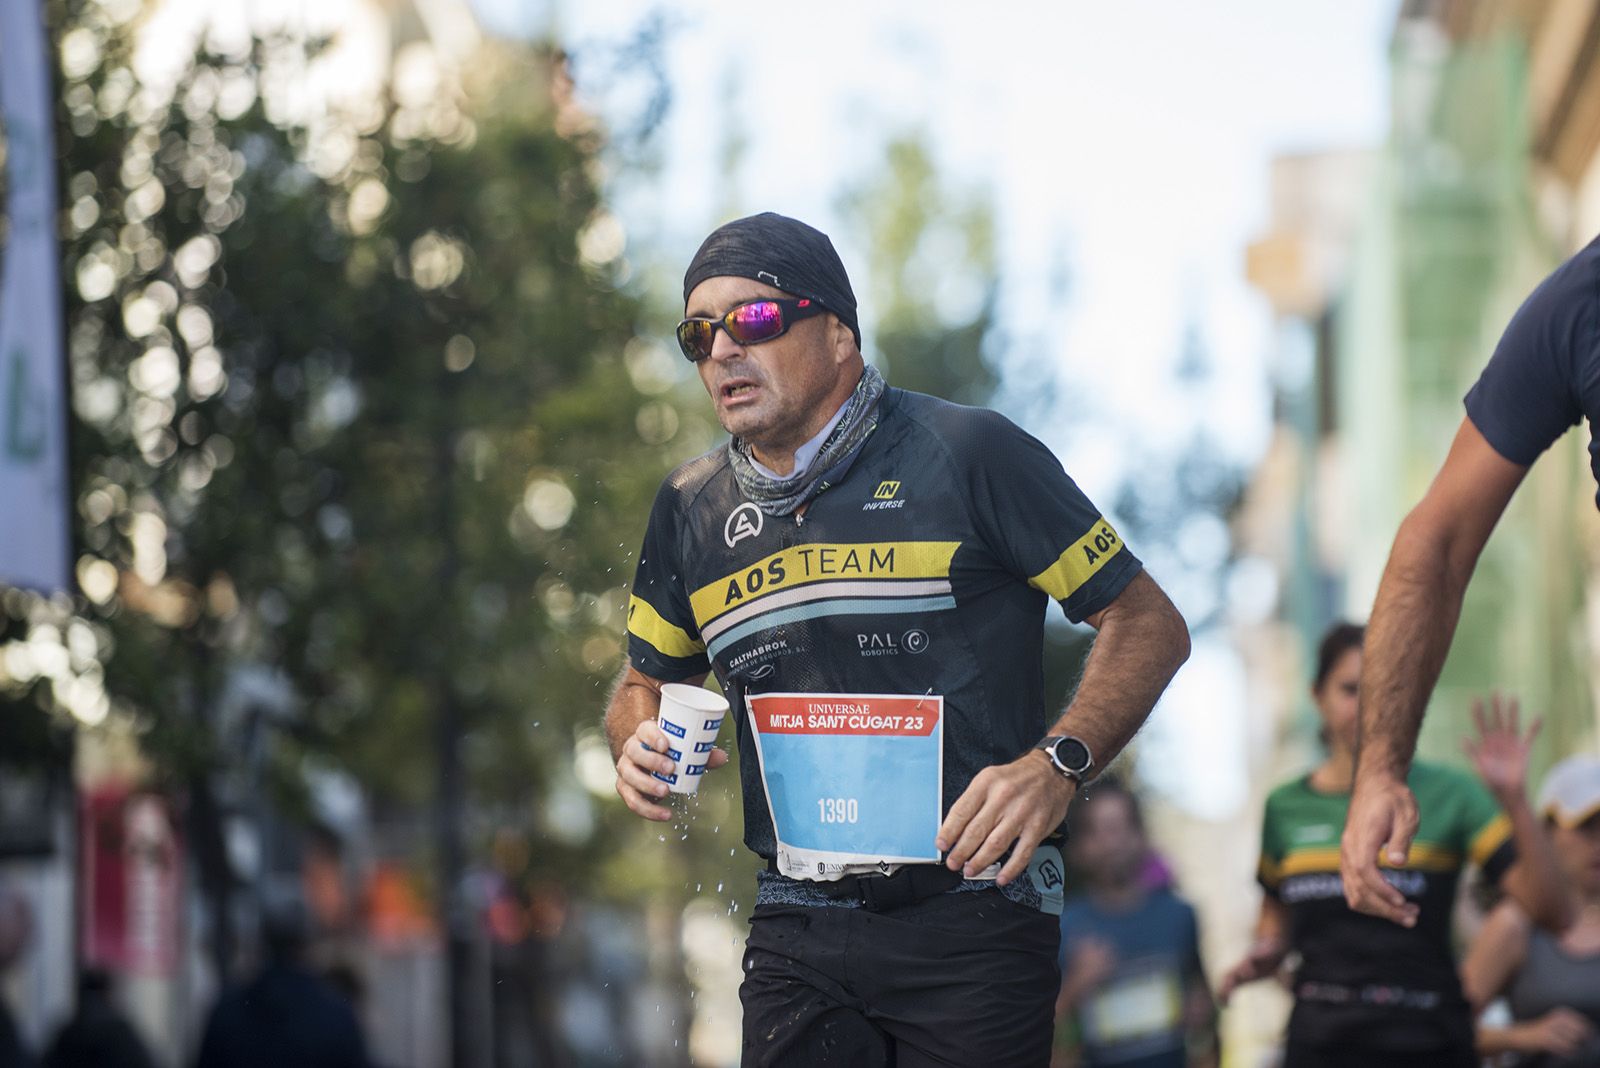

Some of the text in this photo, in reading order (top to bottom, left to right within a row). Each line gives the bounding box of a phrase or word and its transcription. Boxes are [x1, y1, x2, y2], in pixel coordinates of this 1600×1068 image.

[862, 499, 905, 510] INVERSE
[1083, 527, 1117, 566] AOS
[724, 547, 895, 606] AOS TEAM
[857, 633, 897, 649] PAL
[729, 640, 788, 669] CALTHABROK
[861, 648, 899, 657] ROBOTICS
[808, 703, 870, 715] UNIVERSAE
[770, 714, 924, 731] MITJA SANT CUGAT 23
[817, 798, 859, 824] 1390
